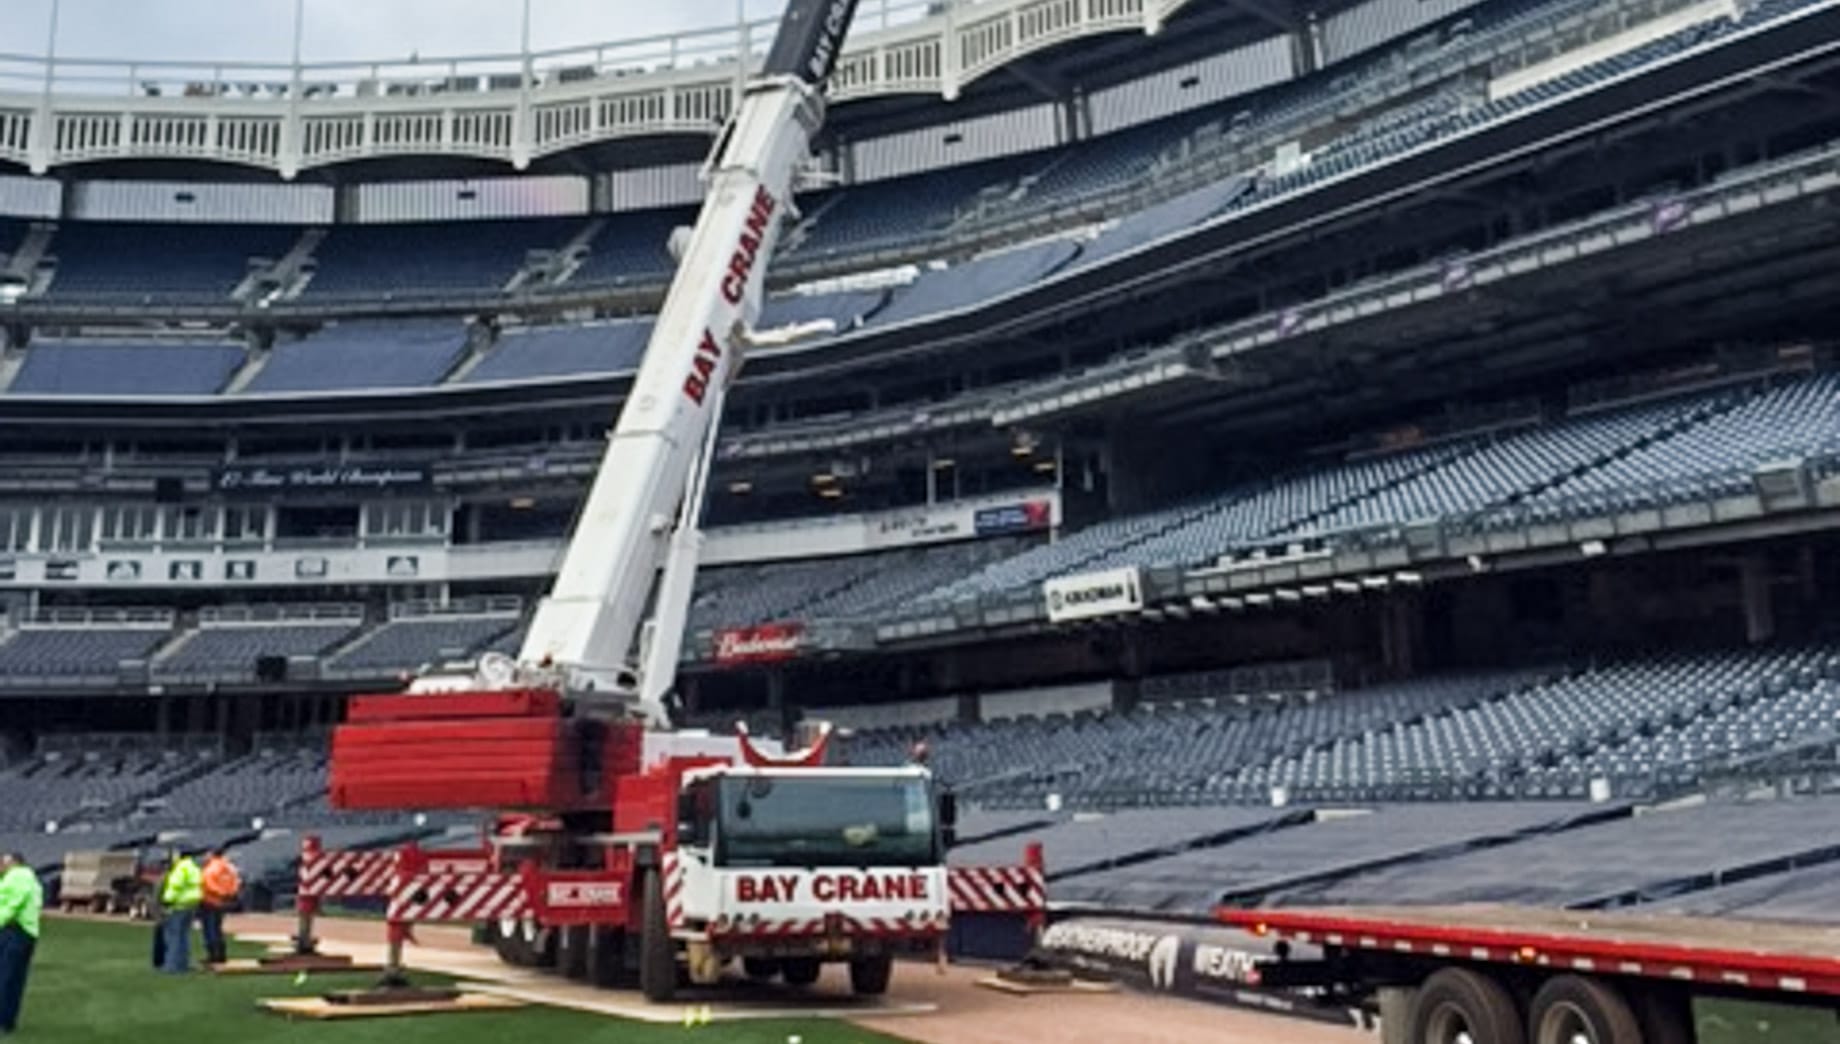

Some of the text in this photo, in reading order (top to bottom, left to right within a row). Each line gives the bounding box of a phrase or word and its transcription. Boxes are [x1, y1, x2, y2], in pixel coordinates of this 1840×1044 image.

[683, 183, 775, 407] BAY CRANE
[737, 874, 928, 902] BAY CRANE
